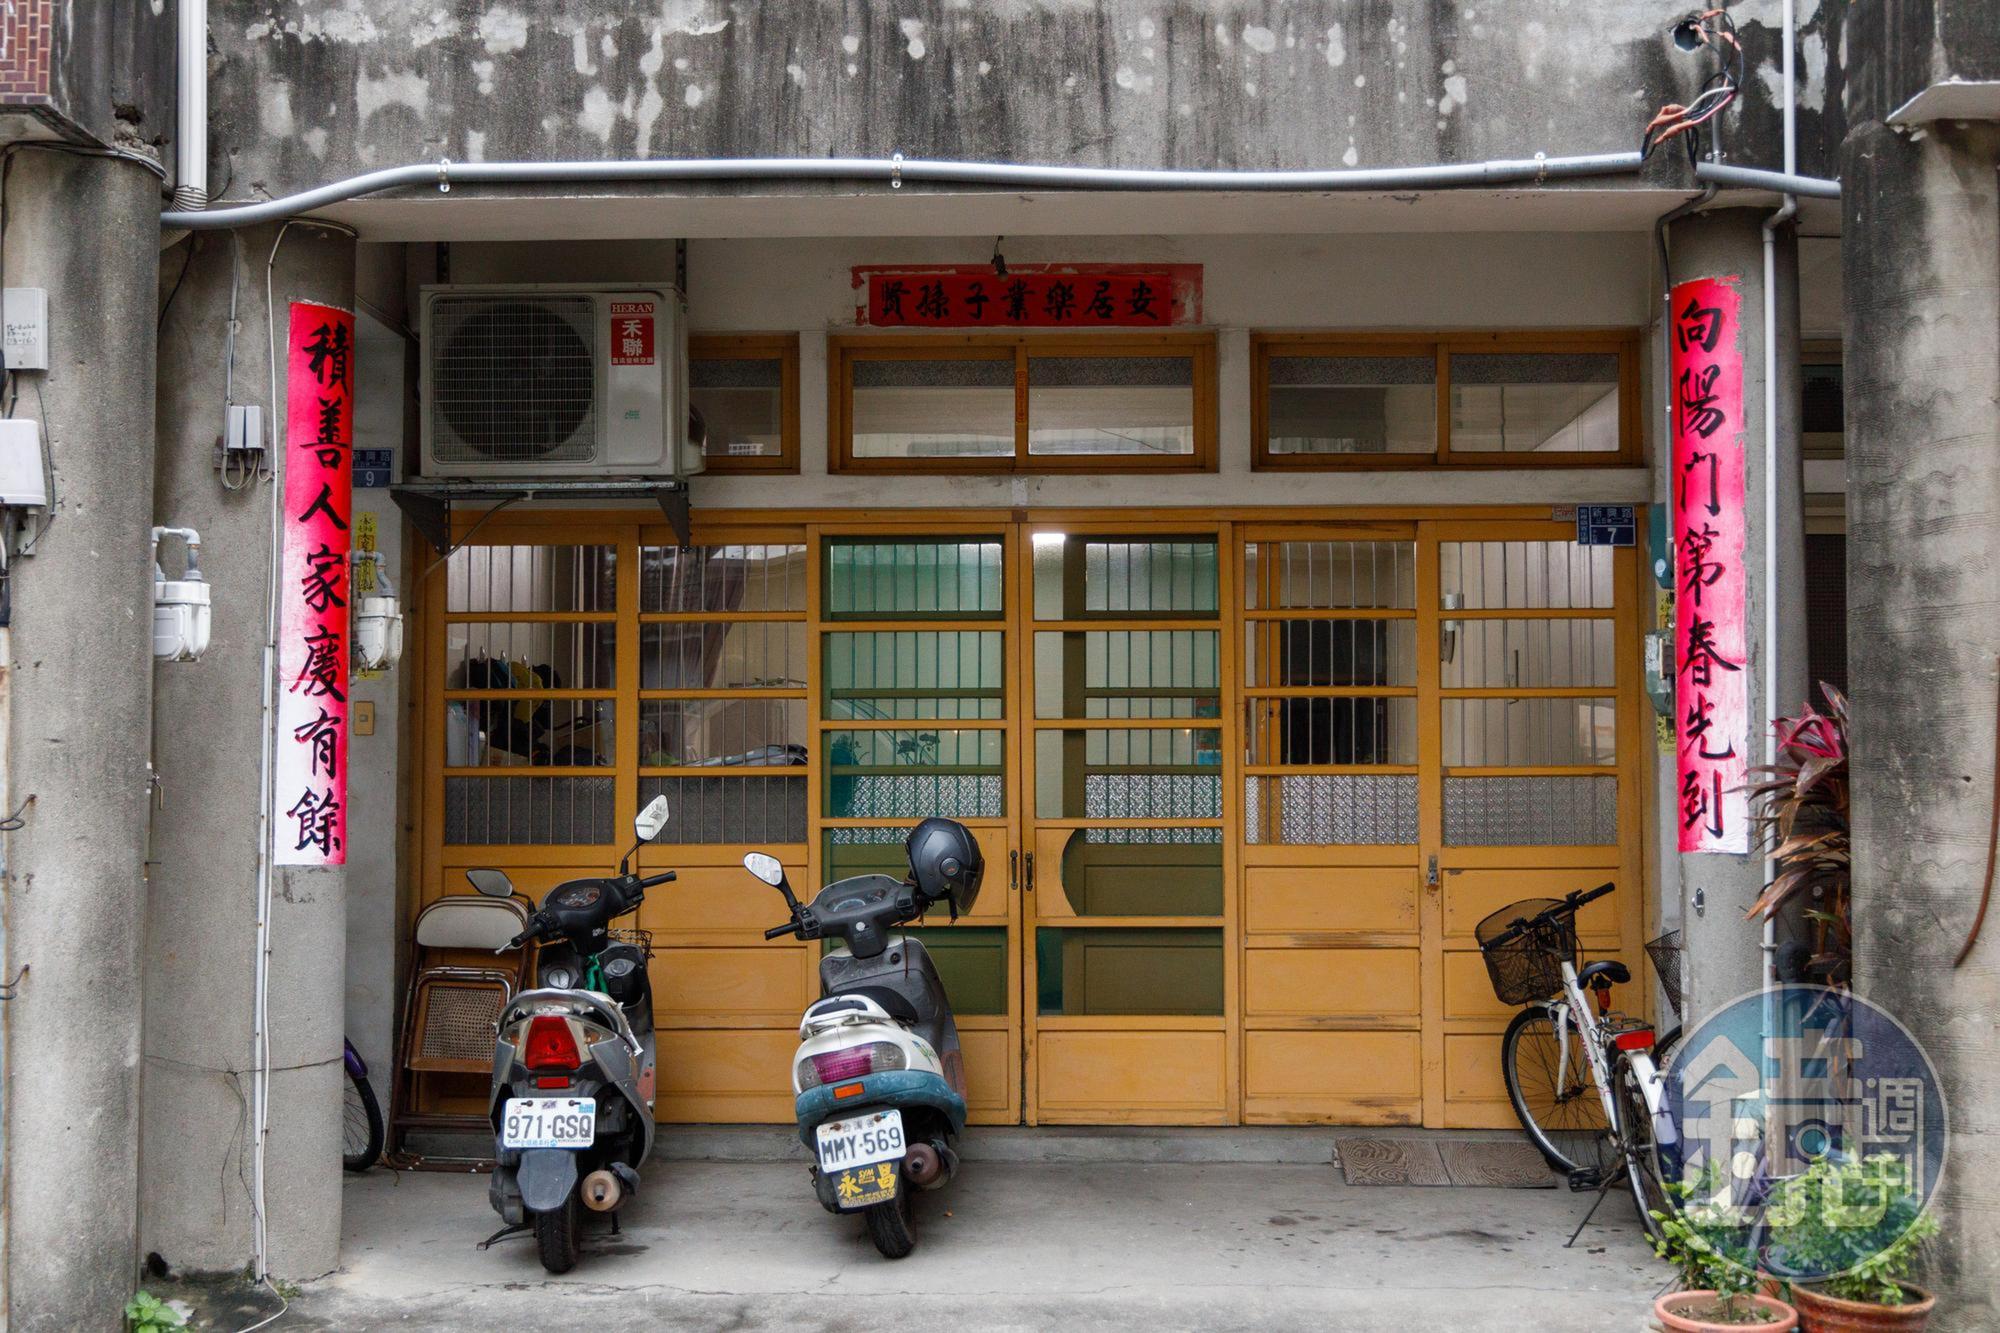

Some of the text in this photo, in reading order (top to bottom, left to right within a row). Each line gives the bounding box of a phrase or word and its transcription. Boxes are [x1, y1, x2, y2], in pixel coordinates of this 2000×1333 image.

[612, 304, 653, 313] HERAN
[622, 320, 643, 356] 禾聯
[366, 470, 375, 487] 9
[1607, 527, 1617, 544] 7
[287, 320, 352, 857] 積善人家慶有餘
[838, 1170, 863, 1198] 永
[877, 1163, 897, 1189] 昌
